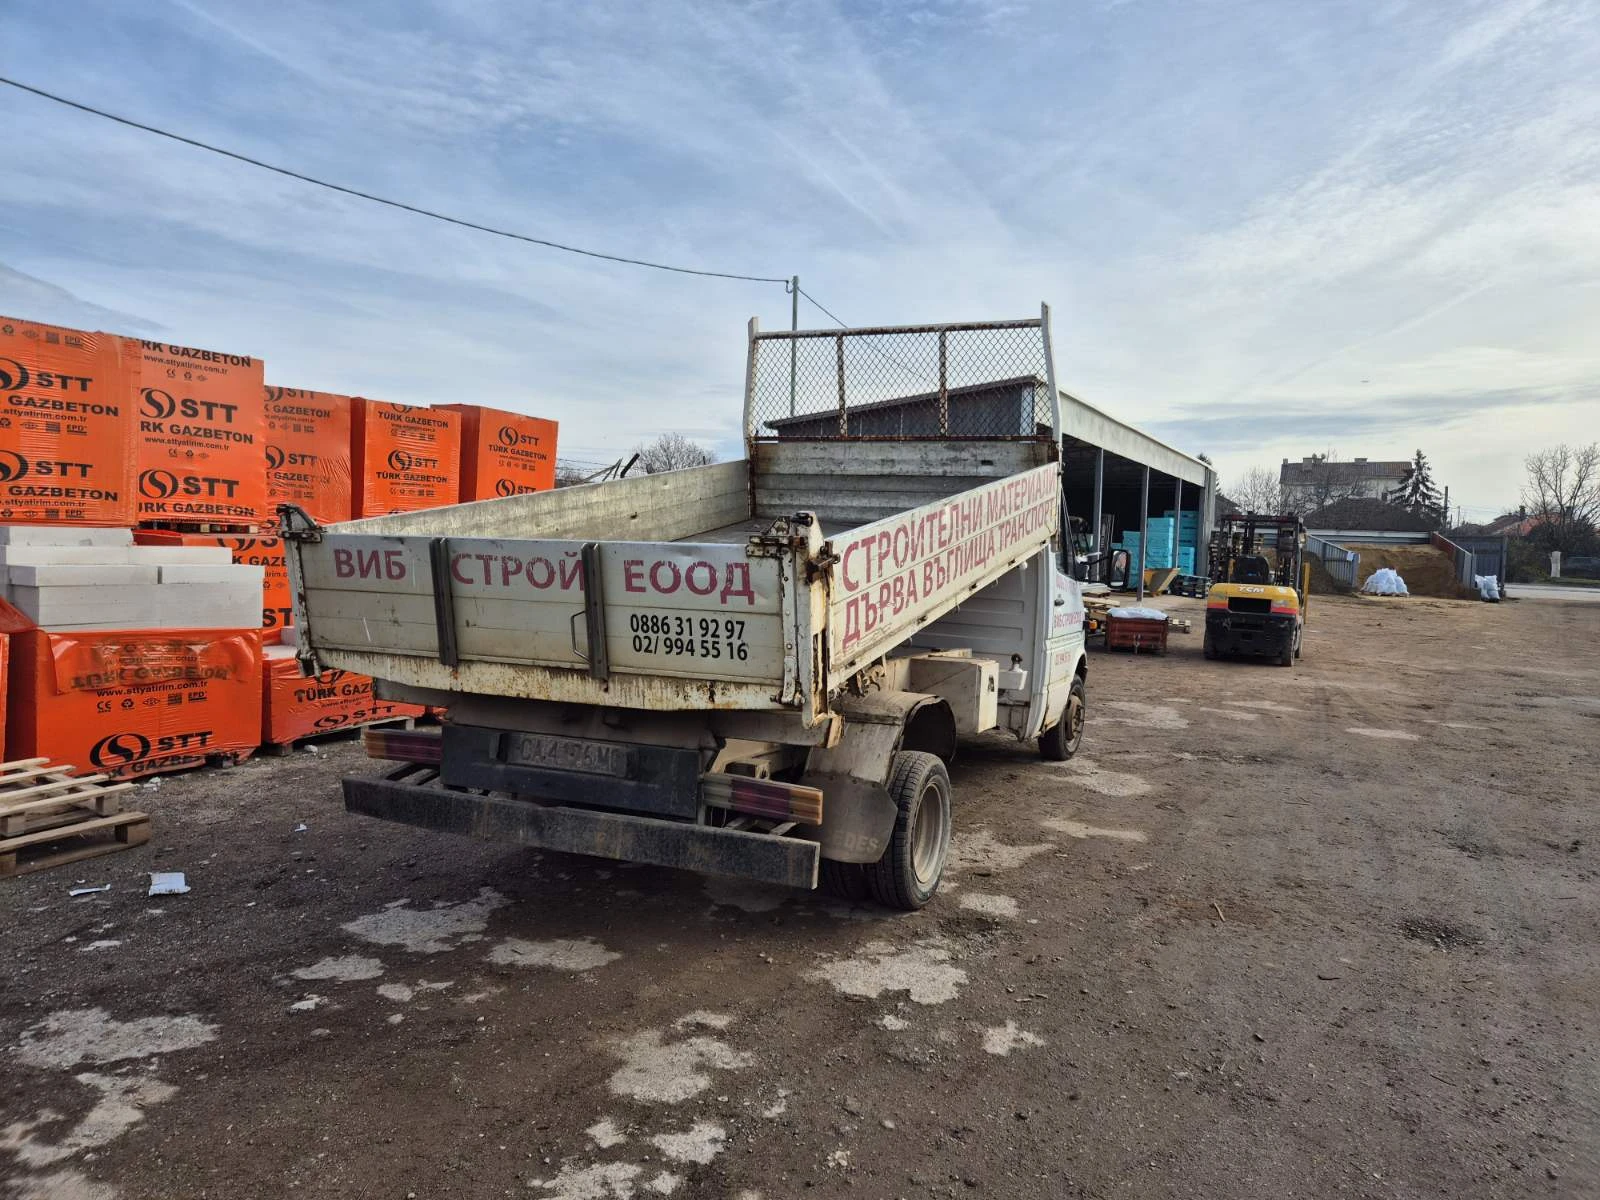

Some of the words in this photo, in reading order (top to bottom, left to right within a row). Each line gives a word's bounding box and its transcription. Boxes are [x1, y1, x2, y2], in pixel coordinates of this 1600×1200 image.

[169, 345, 251, 367] GAZBETON
[37, 372, 93, 392] STT
[8, 395, 119, 416] GAZBETON
[181, 398, 238, 423] STT
[169, 424, 253, 444] GAZBETON
[521, 434, 539, 446] STT
[36, 460, 93, 478] STT
[288, 453, 317, 466] STT
[415, 457, 438, 469] STT
[8, 486, 118, 501] GAZBETON
[182, 475, 239, 498] STT
[173, 502, 256, 517] GAZBETON
[842, 495, 982, 592] СТРОИТЕЛНИ
[987, 467, 1056, 526] МАТЕРИАЛИ
[333, 549, 406, 580] ВИБ
[451, 551, 585, 592] СТРОЙ
[624, 560, 755, 605] ЕООД
[842, 569, 918, 653] ДЪРВА
[923, 530, 995, 598] ВЪГЛИЩА
[999, 498, 1055, 552] ТРАНСПОРТ
[630, 614, 670, 634] 0886
[675, 616, 693, 636] 31
[699, 618, 720, 638] 92
[725, 620, 745, 640] 97
[633, 635, 659, 655] 02/
[664, 637, 695, 656] 994
[700, 640, 720, 658] 55
[726, 642, 748, 660] 16
[96, 681, 208, 697] www.sttyatirim.com.tr
[294, 687, 337, 702] TÜRK
[342, 682, 372, 696] GAZ
[353, 705, 396, 718] STT
[158, 731, 212, 751] STT
